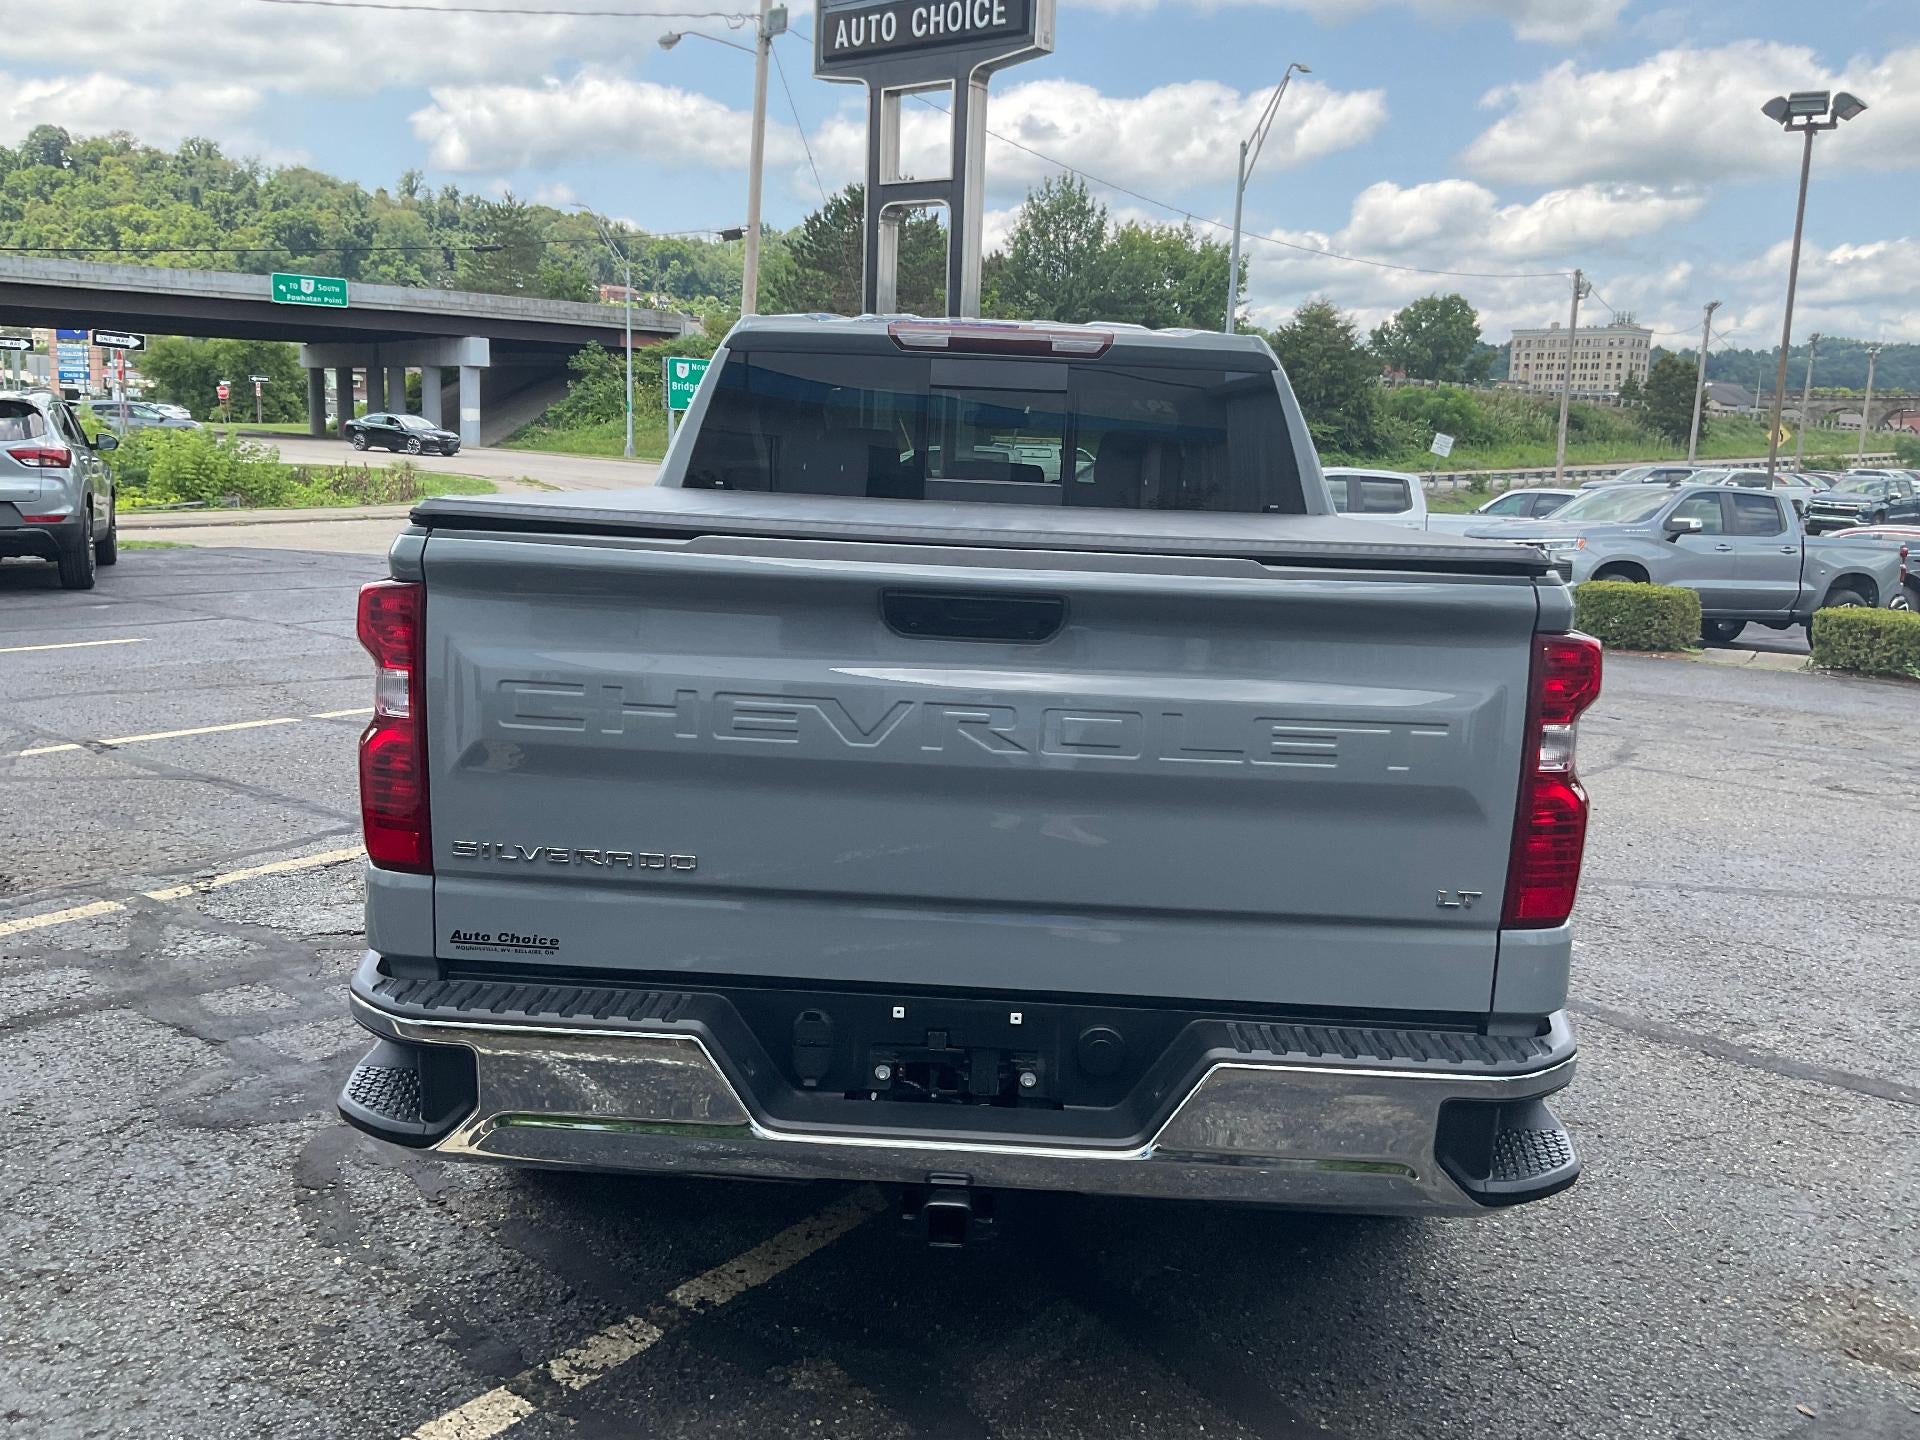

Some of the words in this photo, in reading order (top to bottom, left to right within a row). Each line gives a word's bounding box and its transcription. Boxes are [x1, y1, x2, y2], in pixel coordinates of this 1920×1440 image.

[834, 12, 897, 49] AUTO
[911, 0, 1006, 38] CHOICE
[289, 282, 298, 290] TO
[286, 293, 321, 302] Powhatan
[323, 296, 343, 304] Point
[498, 679, 1450, 770] CHEVROLET
[452, 840, 698, 871] SILVERADO
[1436, 889, 1483, 908] LT
[450, 929, 491, 942] Auto
[497, 932, 560, 946] Choice
